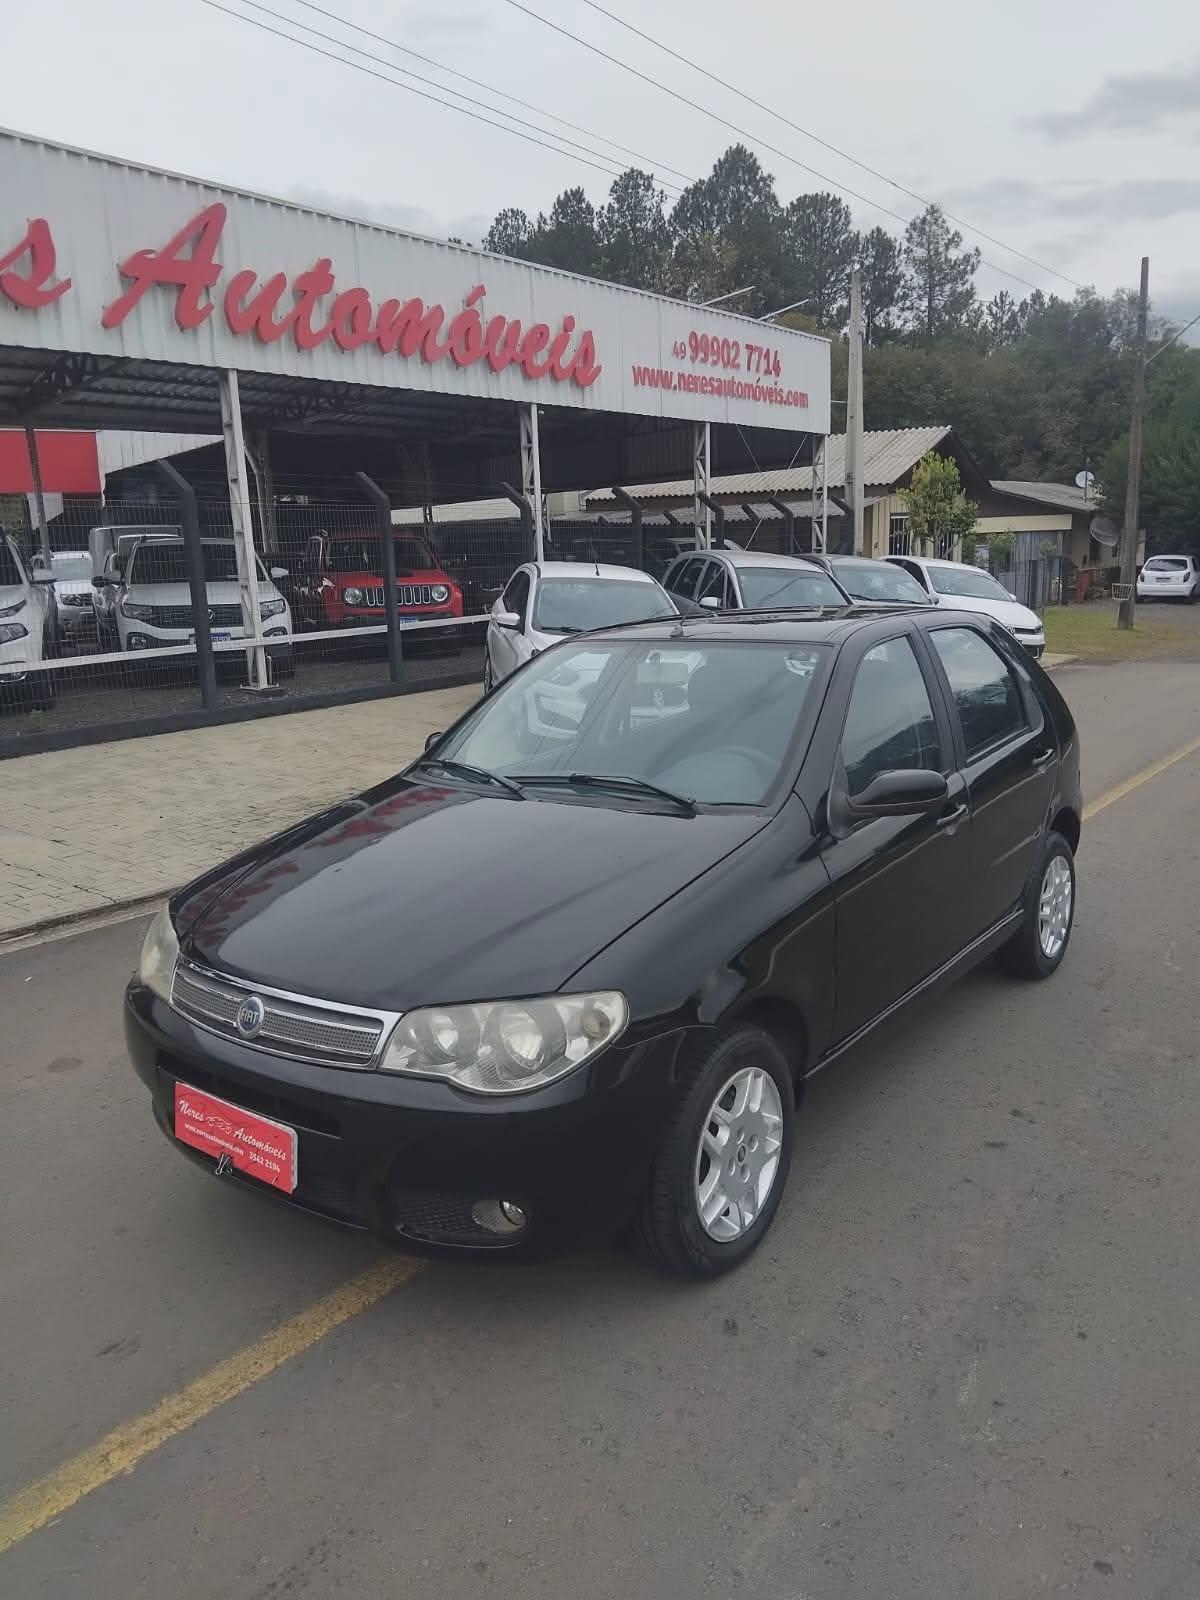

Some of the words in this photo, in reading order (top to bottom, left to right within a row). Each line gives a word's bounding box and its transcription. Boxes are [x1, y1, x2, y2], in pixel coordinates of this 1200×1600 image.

[102, 202, 602, 386] Automóveis
[672, 340, 687, 360] 49
[688, 331, 741, 369] 99902
[745, 343, 782, 377] 7714
[632, 365, 808, 408] www.neresautomóveis.com
[239, 1007, 259, 1025] FIAT
[179, 1100, 204, 1121] Neres
[234, 1127, 286, 1161] Automóveis
